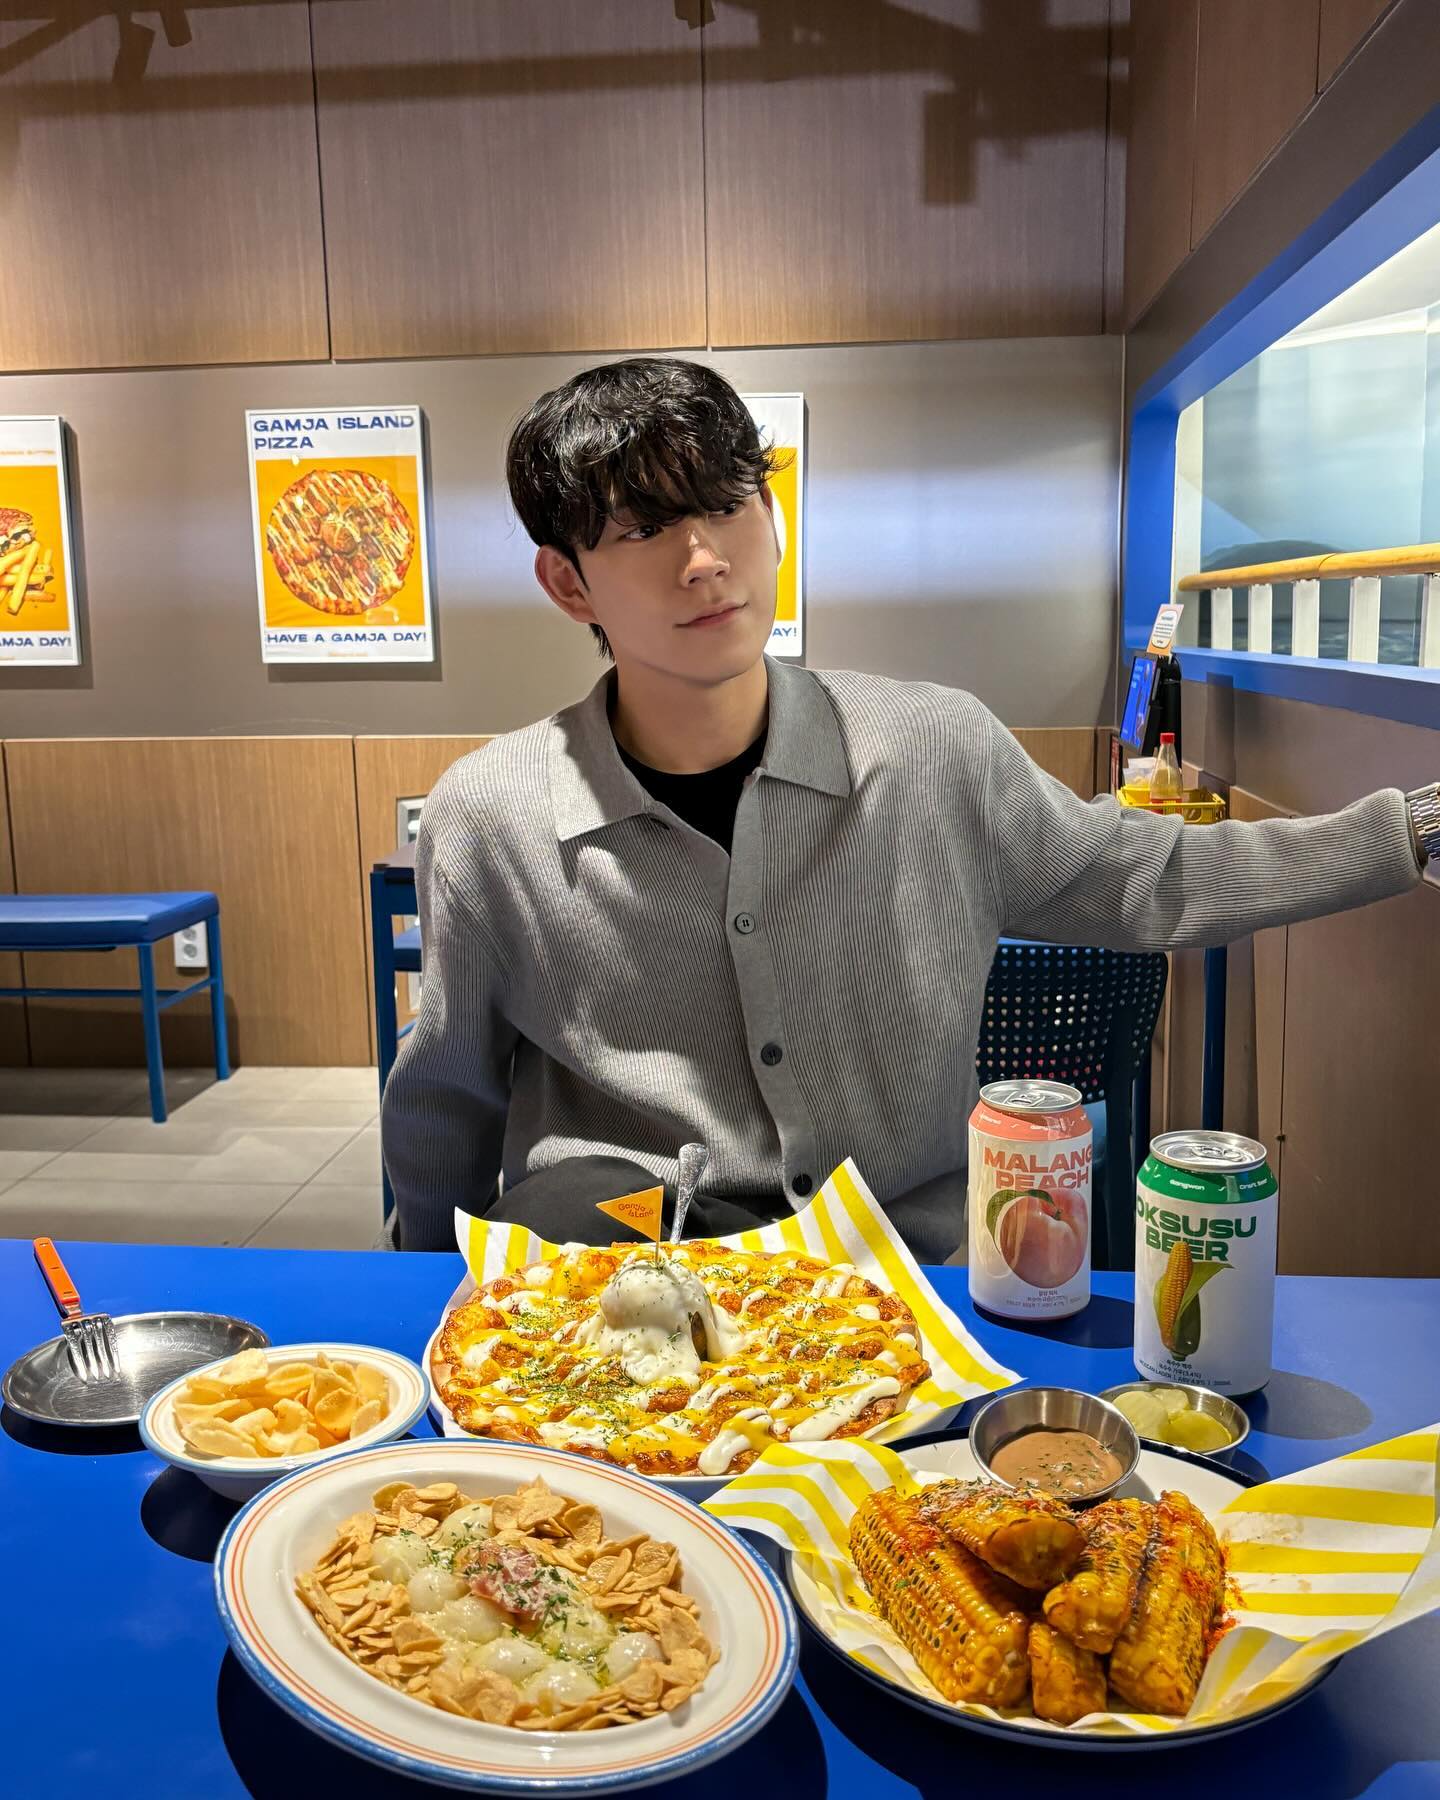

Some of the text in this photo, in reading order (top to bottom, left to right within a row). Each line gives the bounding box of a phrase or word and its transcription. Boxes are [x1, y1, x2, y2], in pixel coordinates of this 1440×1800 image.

[254, 415, 415, 432] GAMJA ISLAND
[255, 436, 314, 450] PIZZA
[267, 632, 427, 643] HAVE A GAMJA DAY!
[772, 627, 798, 638] AY!
[39, 637, 72, 647] DAY!
[995, 1166, 1089, 1193] PEACH
[1145, 1224, 1230, 1262] BEER
